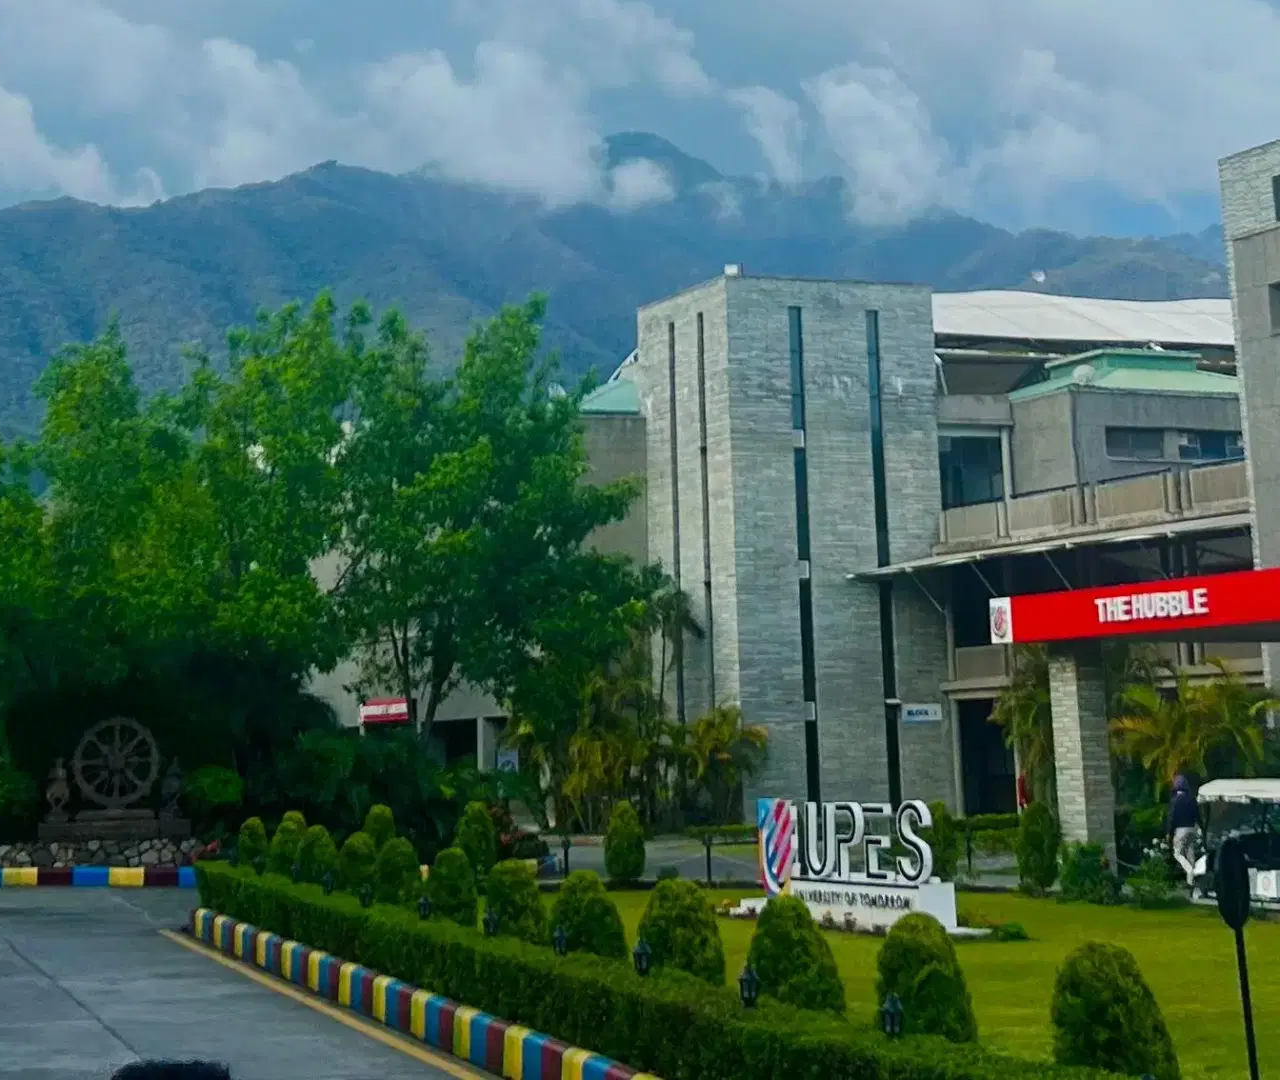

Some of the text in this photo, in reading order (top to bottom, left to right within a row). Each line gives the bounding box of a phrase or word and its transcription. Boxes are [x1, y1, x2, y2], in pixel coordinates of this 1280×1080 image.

[1094, 588, 1209, 623] THE HUBBLE
[804, 800, 933, 884] UPES
